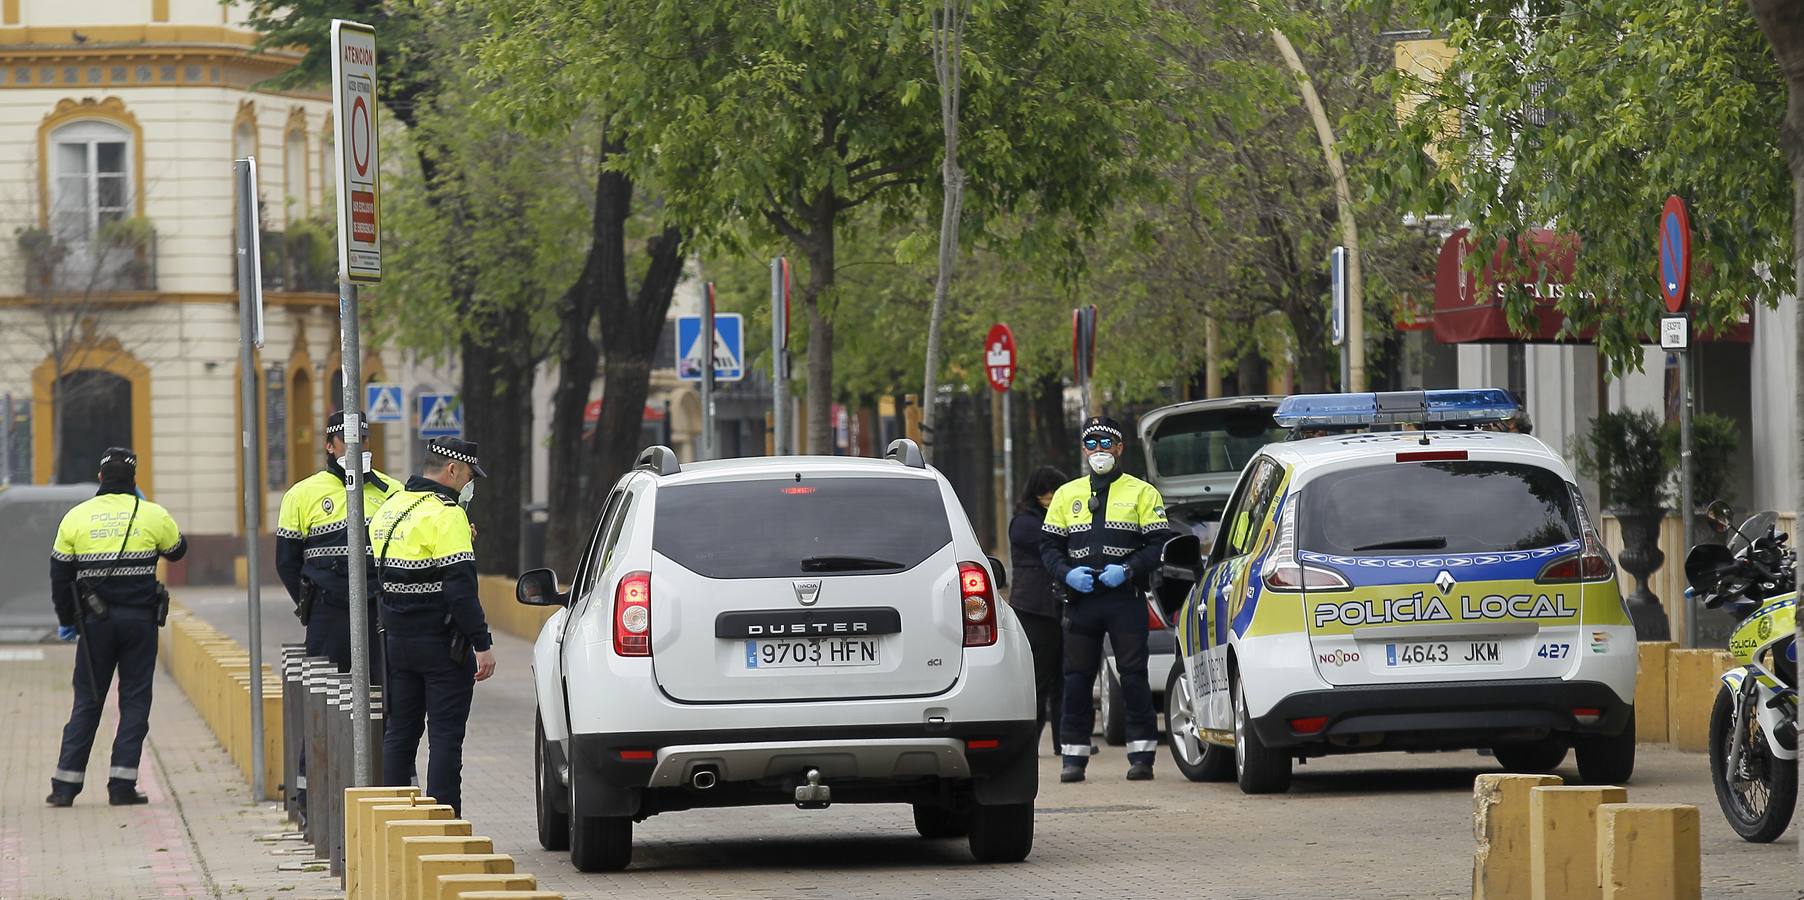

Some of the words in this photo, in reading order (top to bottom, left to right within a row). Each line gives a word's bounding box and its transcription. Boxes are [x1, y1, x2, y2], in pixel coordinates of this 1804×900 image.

[344, 44, 373, 66] ATENCIÓN
[1314, 591, 1453, 628] POLICÍA
[1461, 594, 1578, 620] LOCAL
[748, 622, 869, 635] DUSTER
[762, 642, 822, 664] 9703
[830, 641, 876, 662] HFN
[1401, 643, 1449, 664] 4643
[1464, 643, 1500, 662] JKM
[1537, 643, 1570, 659] 427
